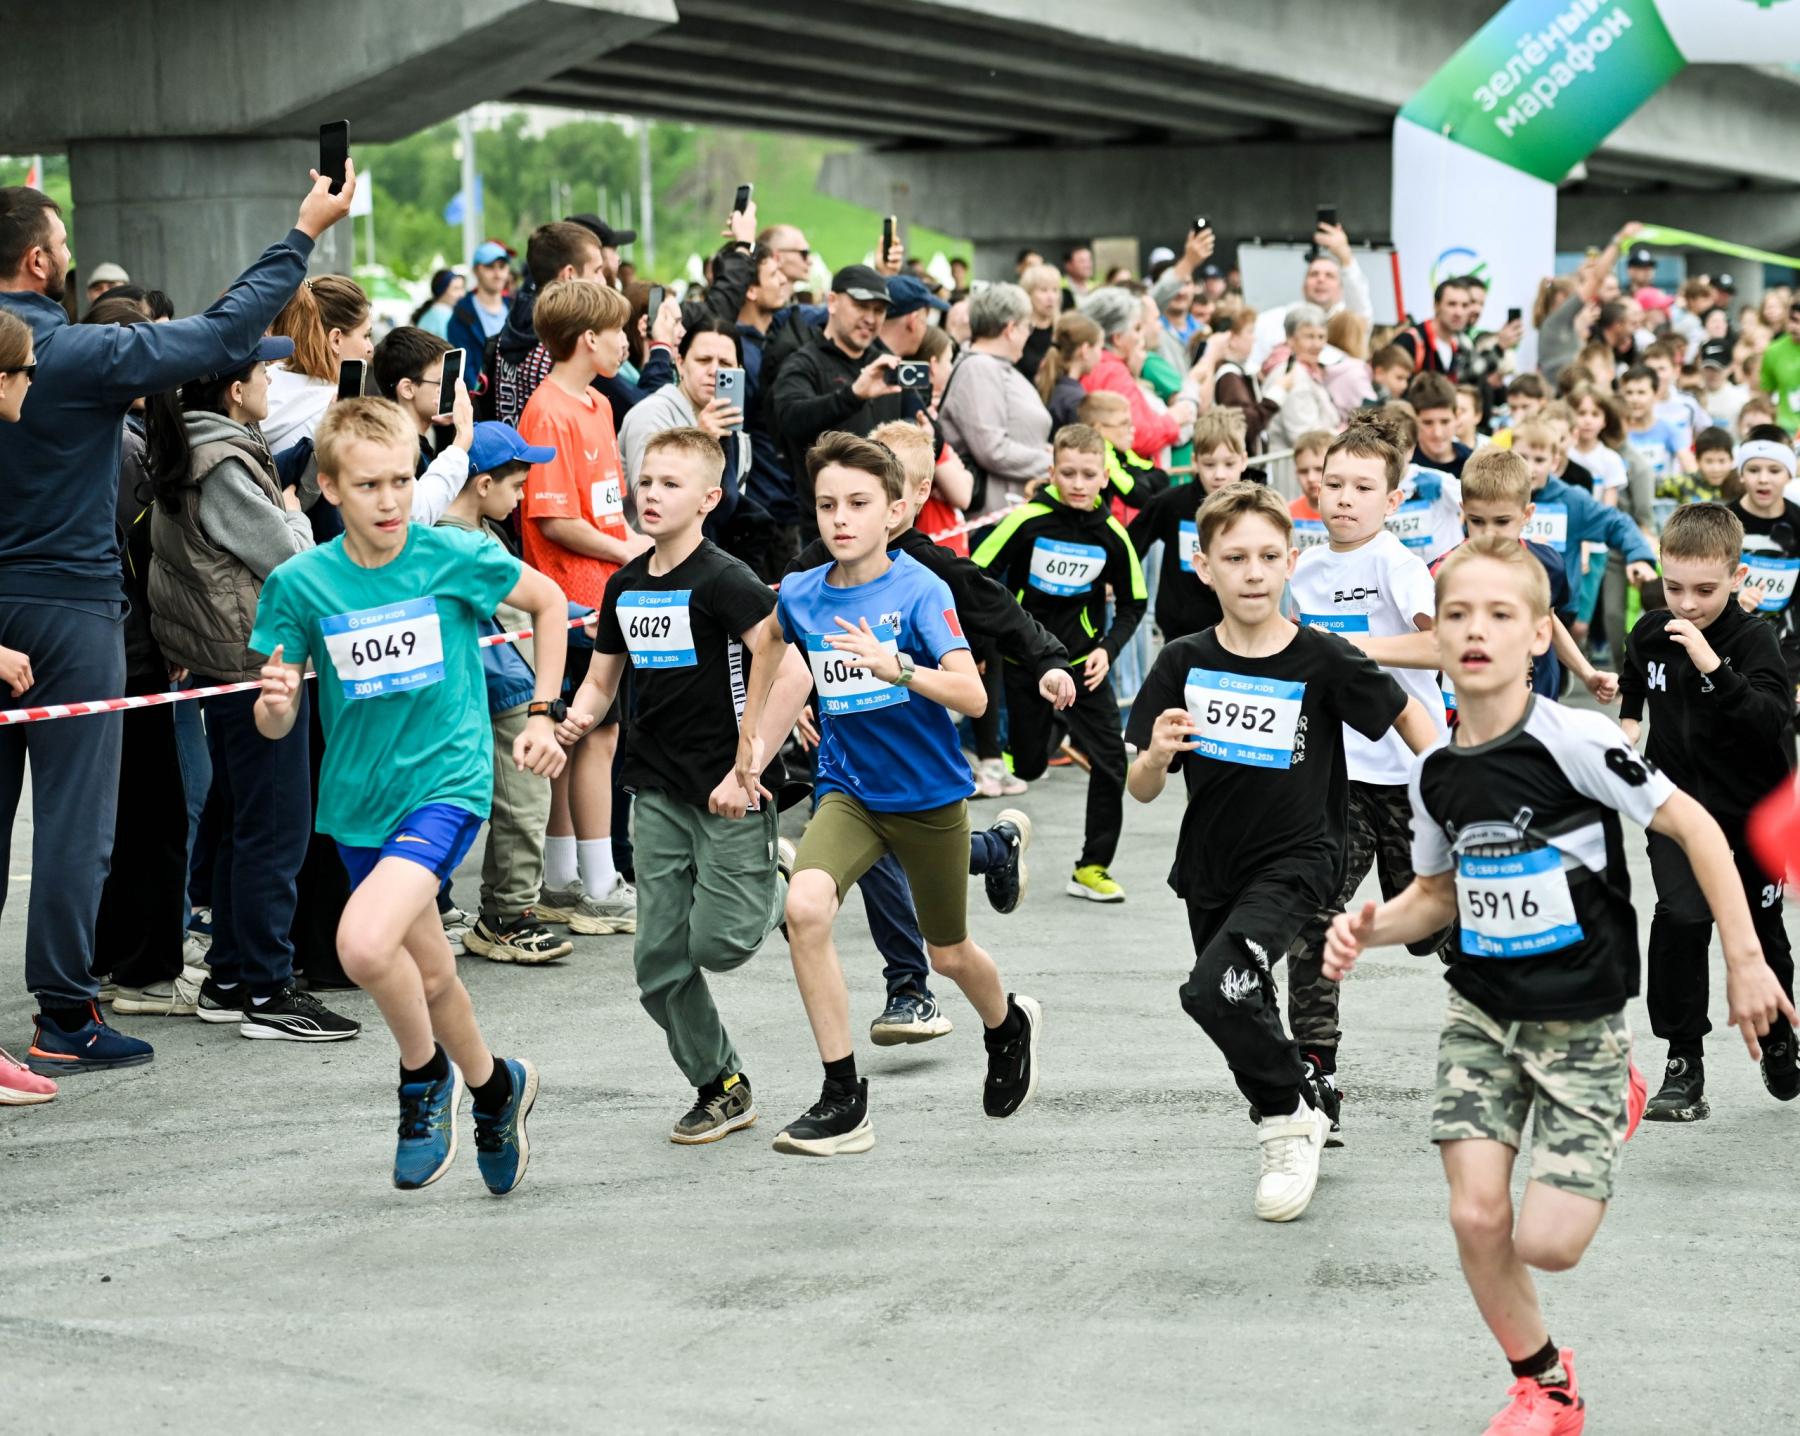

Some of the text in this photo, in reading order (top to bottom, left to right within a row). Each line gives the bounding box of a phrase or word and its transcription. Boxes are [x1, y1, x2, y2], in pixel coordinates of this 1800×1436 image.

[1494, 6, 1633, 137] марафон
[1519, 521, 1553, 535] 510
[1046, 560, 1089, 578] 6077
[630, 616, 671, 638] 6029
[351, 631, 416, 666] 6049
[824, 657, 875, 684] 604
[1647, 661, 1666, 692] 34
[1231, 681, 1275, 693] СБЕР KIDS
[1206, 699, 1276, 734] 5952
[1200, 740, 1218, 755] 500
[1467, 890, 1539, 920] 5916
